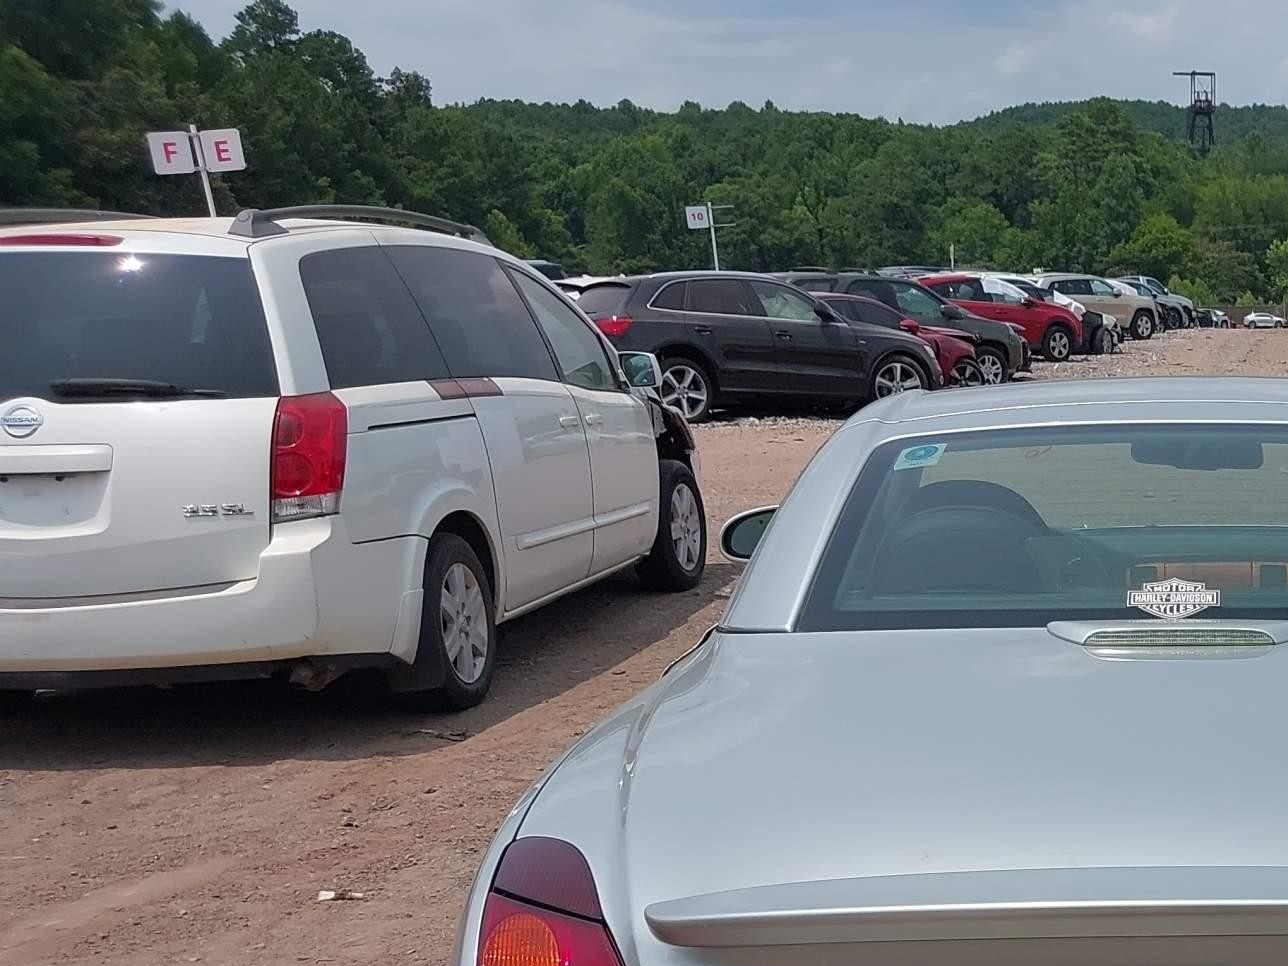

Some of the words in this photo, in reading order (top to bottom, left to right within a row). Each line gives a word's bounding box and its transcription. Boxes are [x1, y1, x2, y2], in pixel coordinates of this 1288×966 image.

[163, 142, 177, 164] F
[214, 140, 232, 162] E
[691, 212, 704, 221] 10
[1134, 592, 1213, 603] HARLEY-DAVIDSON
